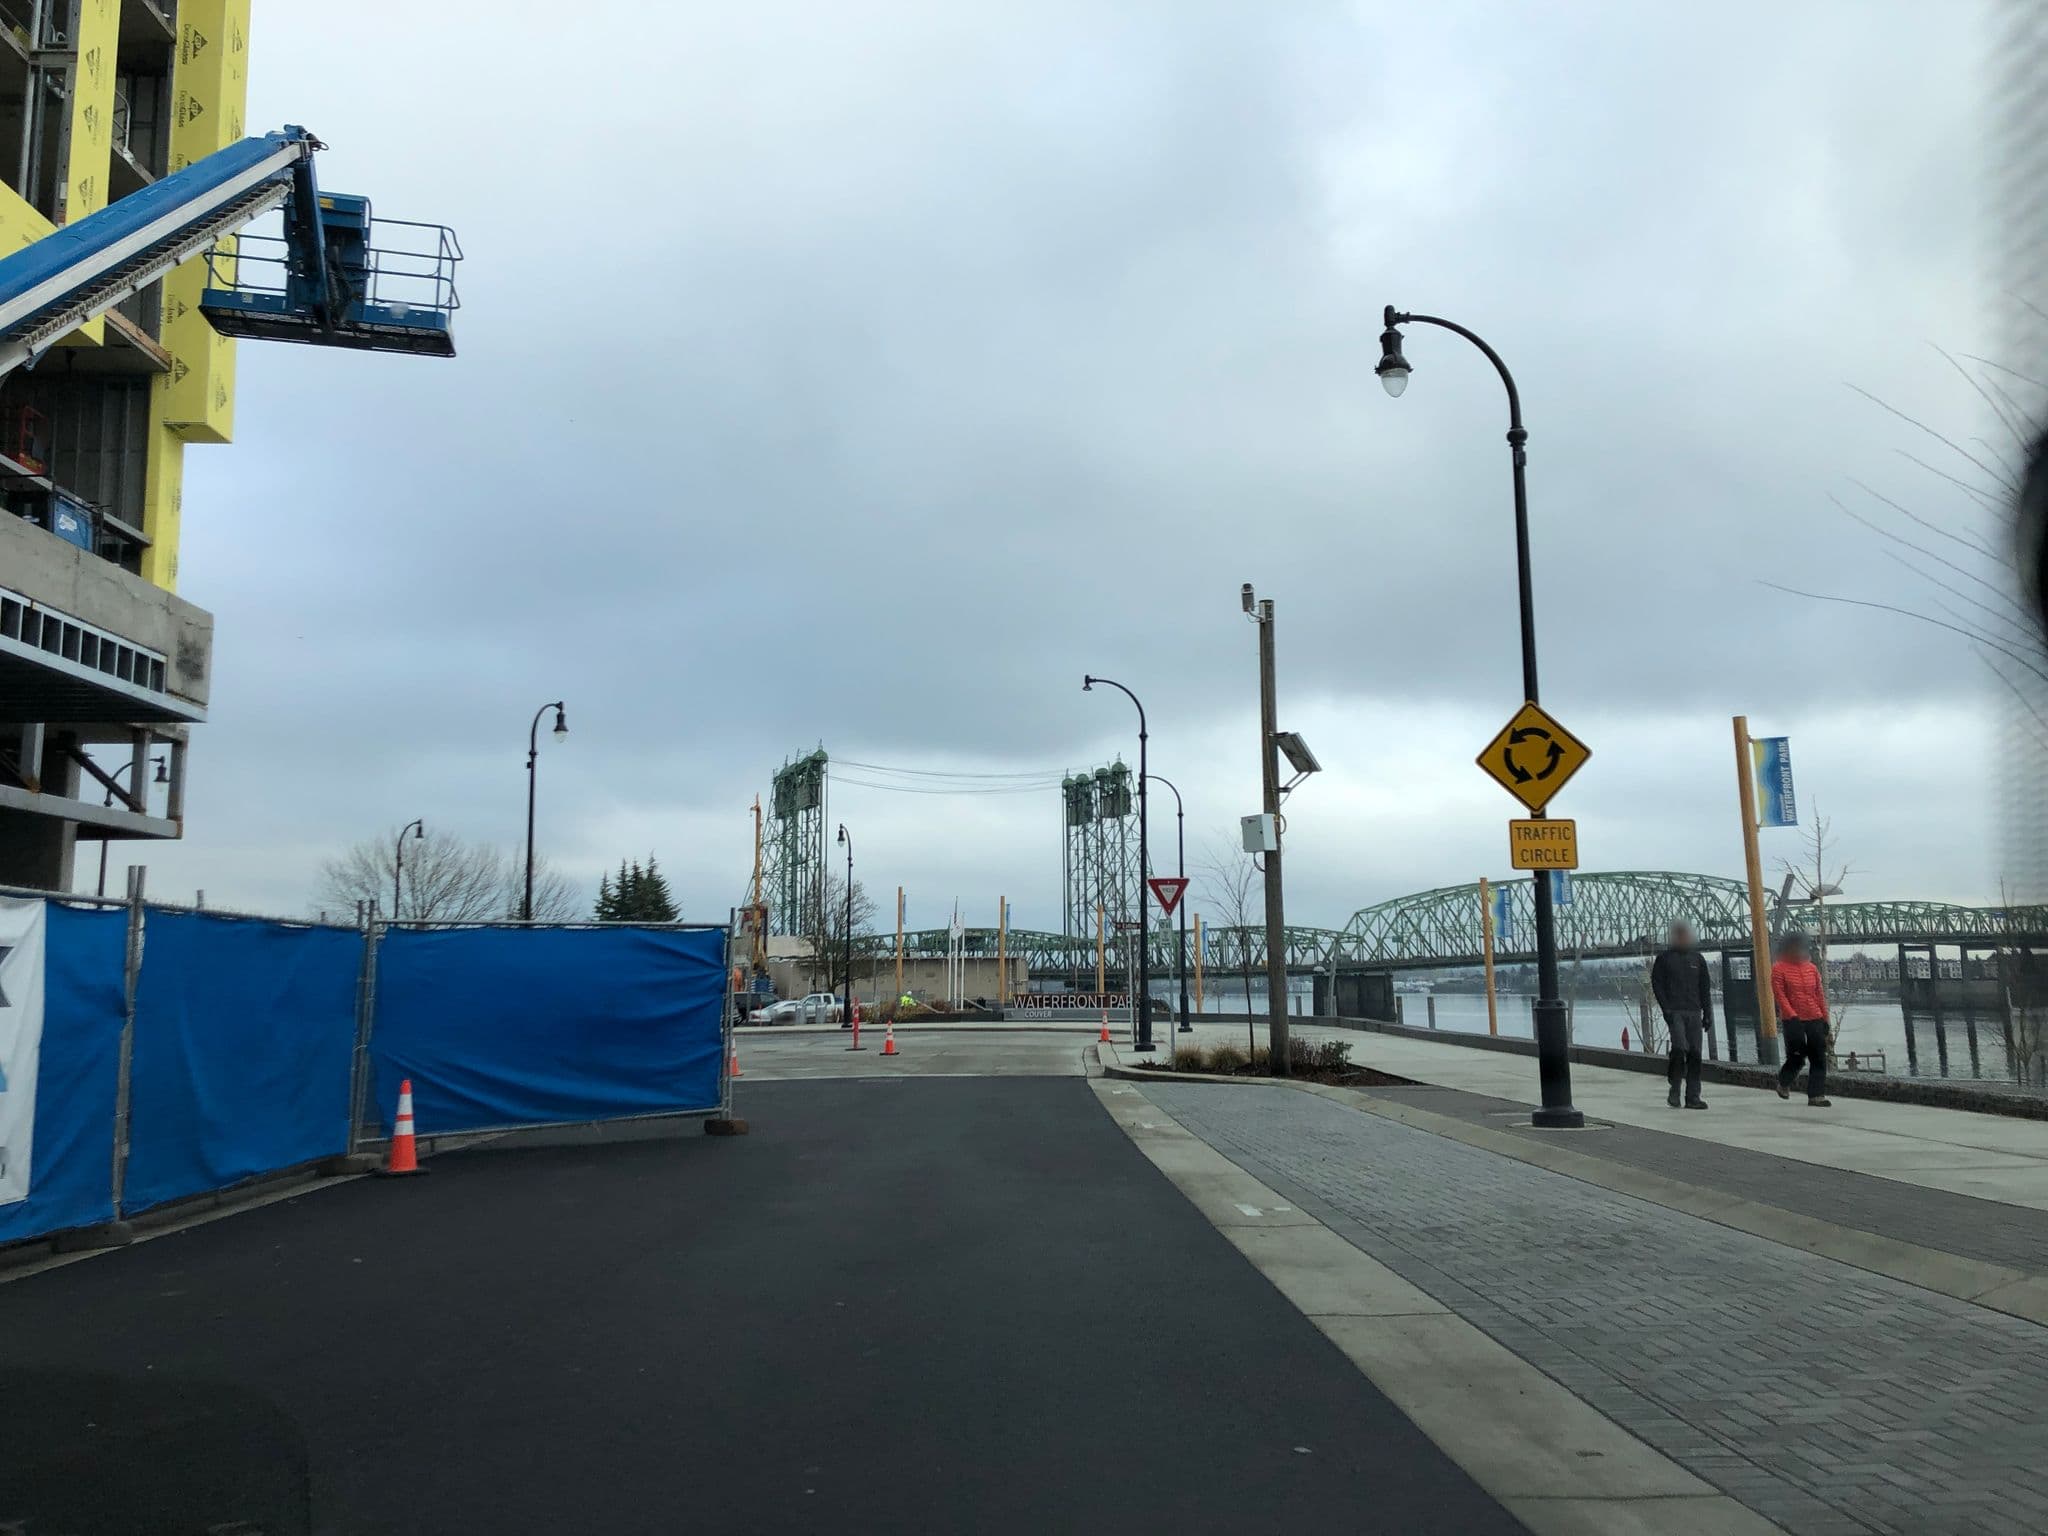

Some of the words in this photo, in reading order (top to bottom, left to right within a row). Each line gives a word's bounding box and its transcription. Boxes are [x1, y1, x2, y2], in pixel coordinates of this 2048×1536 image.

[1778, 741, 1789, 763] PARK
[1781, 766, 1796, 822] WATERFRONT
[1515, 826, 1572, 841] TRAFFIC
[1520, 848, 1569, 863] CIRCLE
[1013, 995, 1106, 1009] WATERFRONT
[1109, 995, 1133, 1009] PAR
